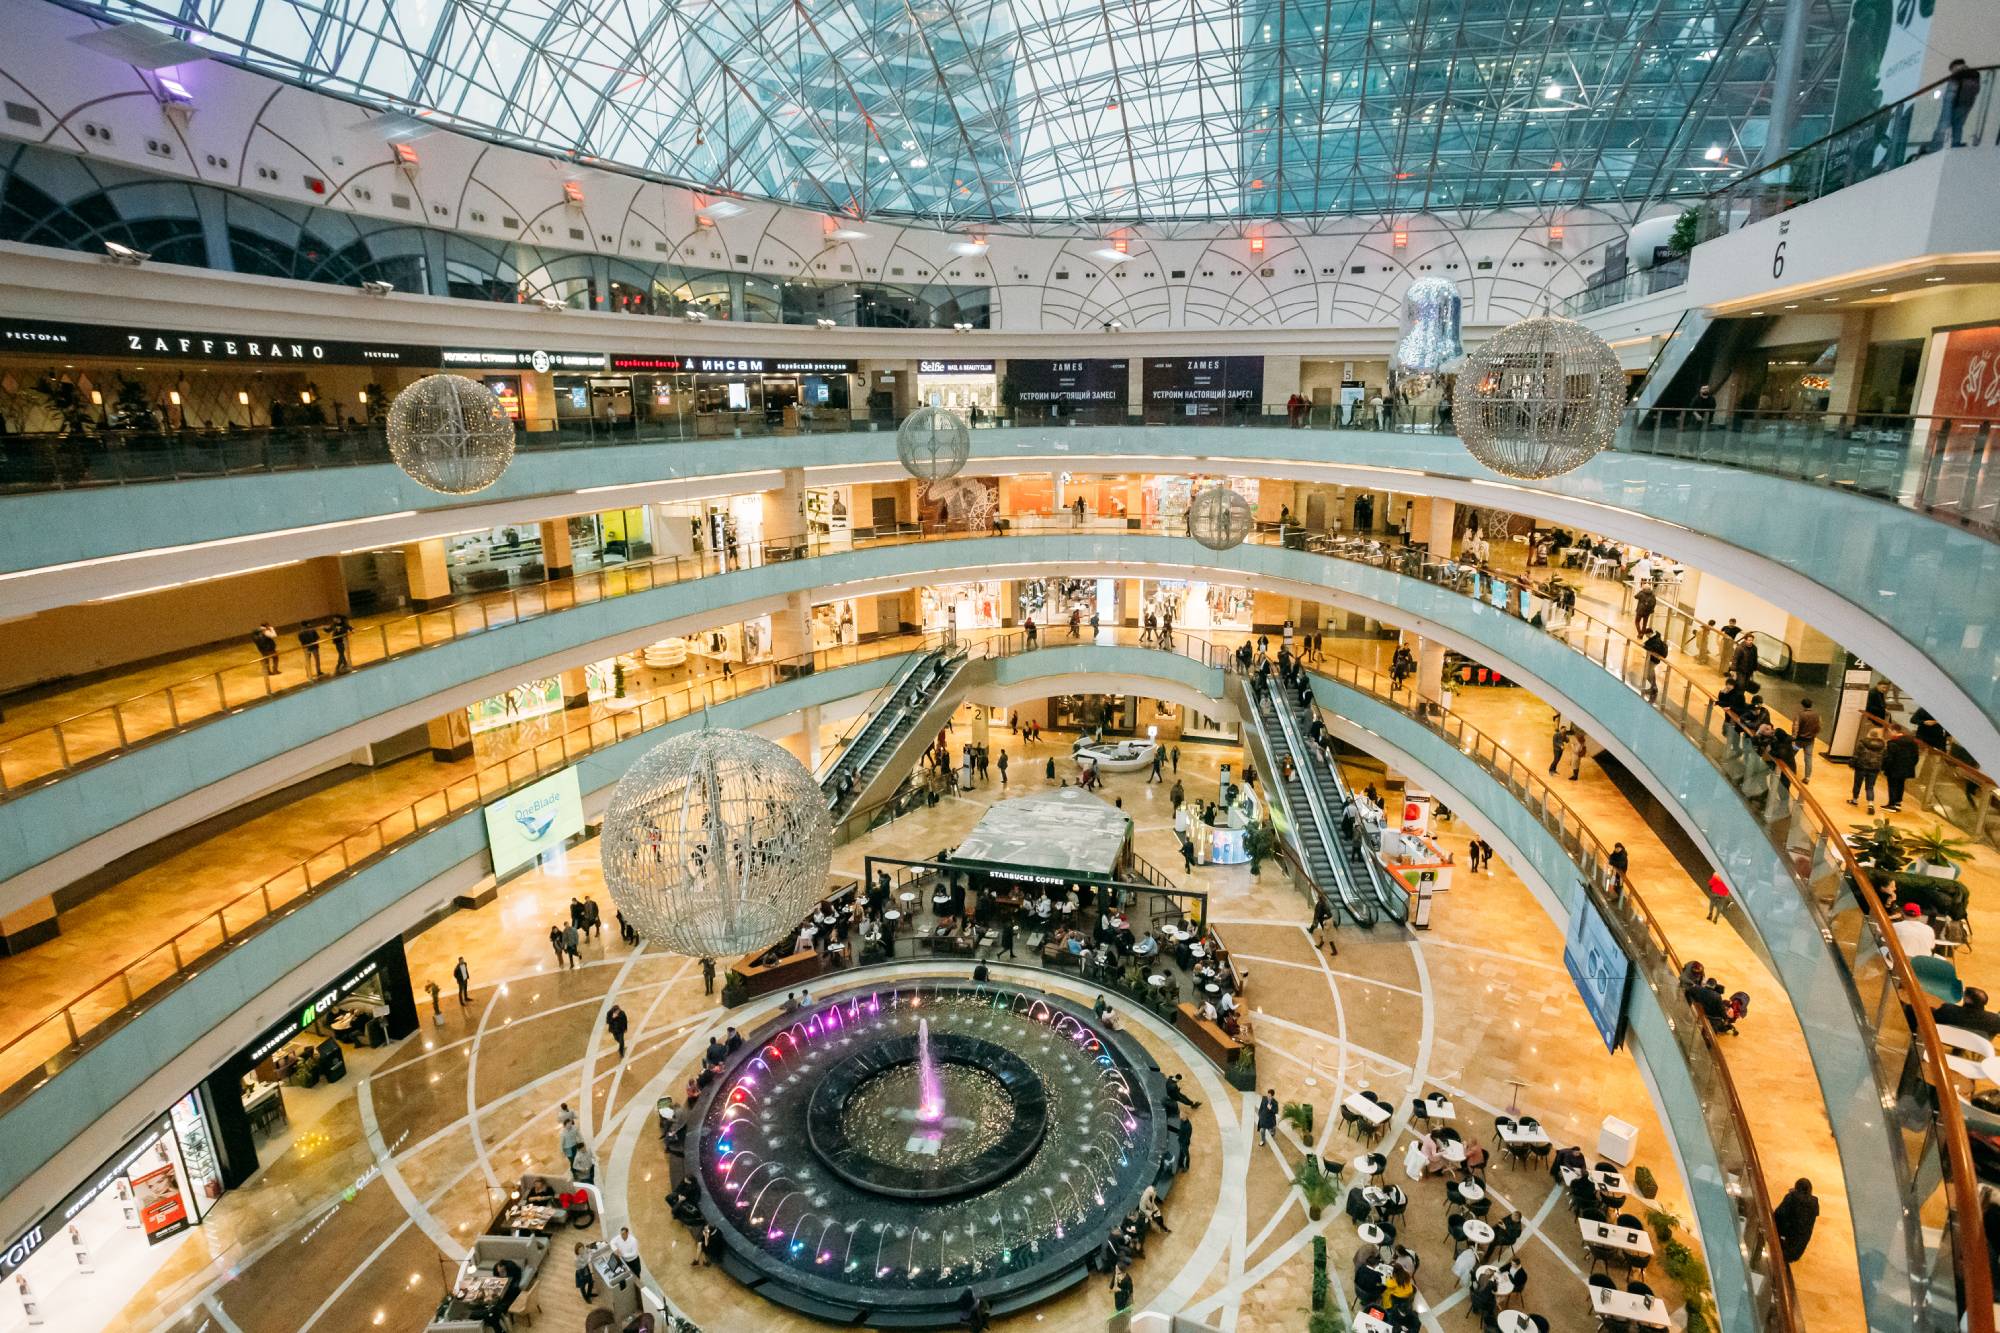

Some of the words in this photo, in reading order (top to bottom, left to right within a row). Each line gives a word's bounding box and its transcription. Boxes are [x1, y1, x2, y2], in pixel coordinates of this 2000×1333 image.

[1773, 241, 1786, 279] 6
[6, 331, 67, 342] РЕСТОРАН
[128, 335, 323, 359] ZAFFERANO
[920, 361, 945, 372] Selfie
[1052, 363, 1083, 372] ZAMES
[1188, 361, 1220, 370] ZAMES
[858, 372, 866, 387] 5
[1020, 392, 1049, 400] УСТРОИМ
[1092, 391, 1116, 399] ЗАМЕС!
[1153, 391, 1184, 399] УСТРОИМ
[1185, 389, 1226, 400] НАСТОЯЩИЙ
[804, 619, 810, 635] 3
[1854, 658, 1866, 669] 4
[974, 709, 982, 720] 2
[514, 792, 560, 820] OneBlade
[990, 871, 1034, 882] STARBUCKS
[1035, 876, 1064, 885] COFFEE
[316, 989, 338, 1013] CITY
